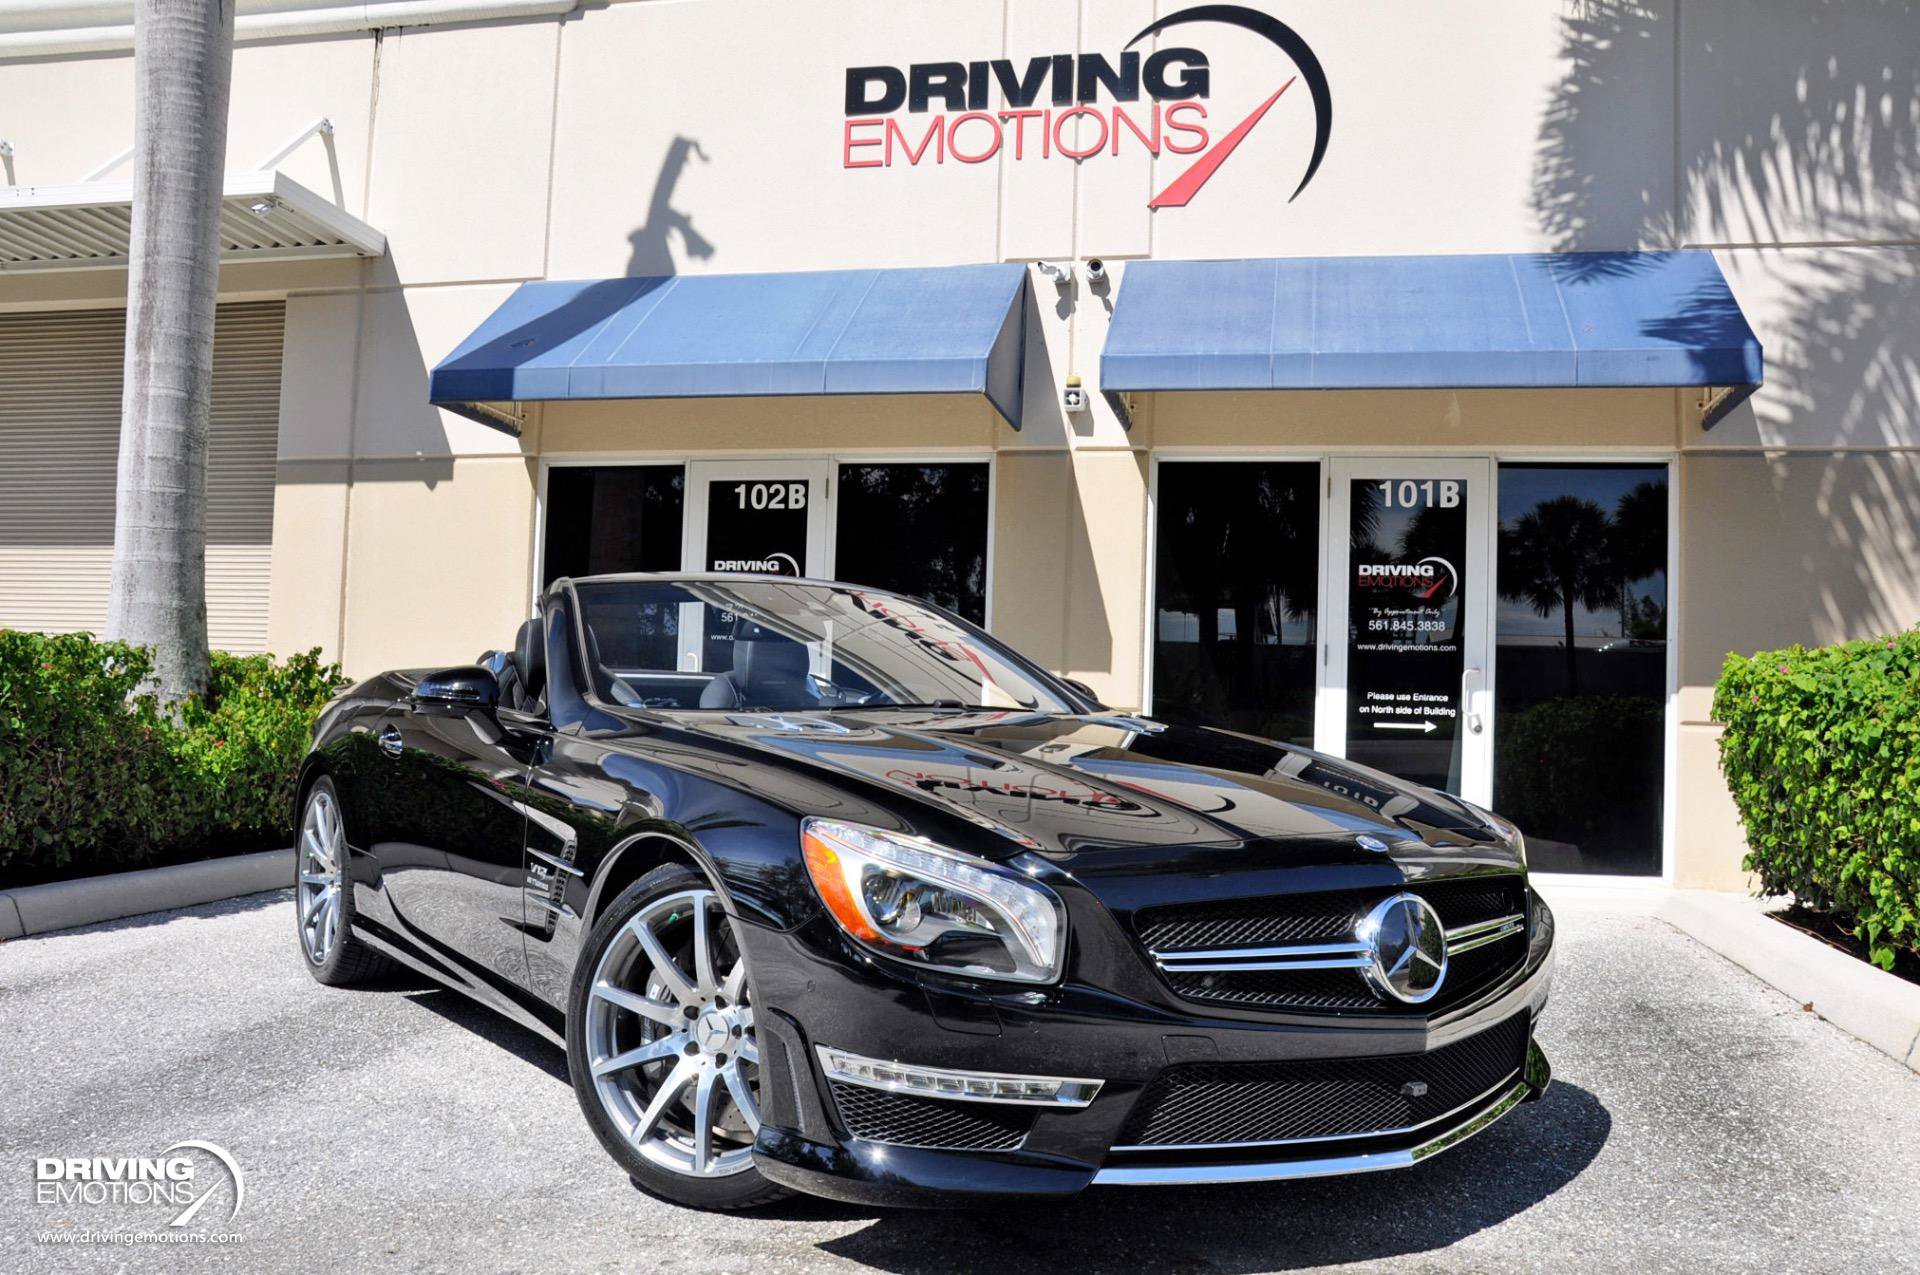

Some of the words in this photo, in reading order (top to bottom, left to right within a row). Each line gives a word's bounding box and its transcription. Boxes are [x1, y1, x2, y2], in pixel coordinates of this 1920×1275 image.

[845, 47, 1210, 116] DRIVING
[844, 101, 1209, 168] EMOTIONS
[734, 483, 806, 510] 102B
[1379, 480, 1460, 508] 101B
[714, 560, 780, 572] DRIVING
[1358, 564, 1434, 576] DRIVING
[1357, 576, 1434, 588] EMOTIONS
[1368, 620, 1446, 632] 561.845.3838
[1357, 643, 1457, 653] www.drivingemotions.com
[1367, 692, 1395, 701] Please
[1396, 693, 1411, 701] use
[1413, 693, 1448, 702] Entrance
[1371, 705, 1394, 714] North
[1395, 705, 1412, 715] side
[1413, 706, 1422, 715] of
[1424, 706, 1456, 718] Building
